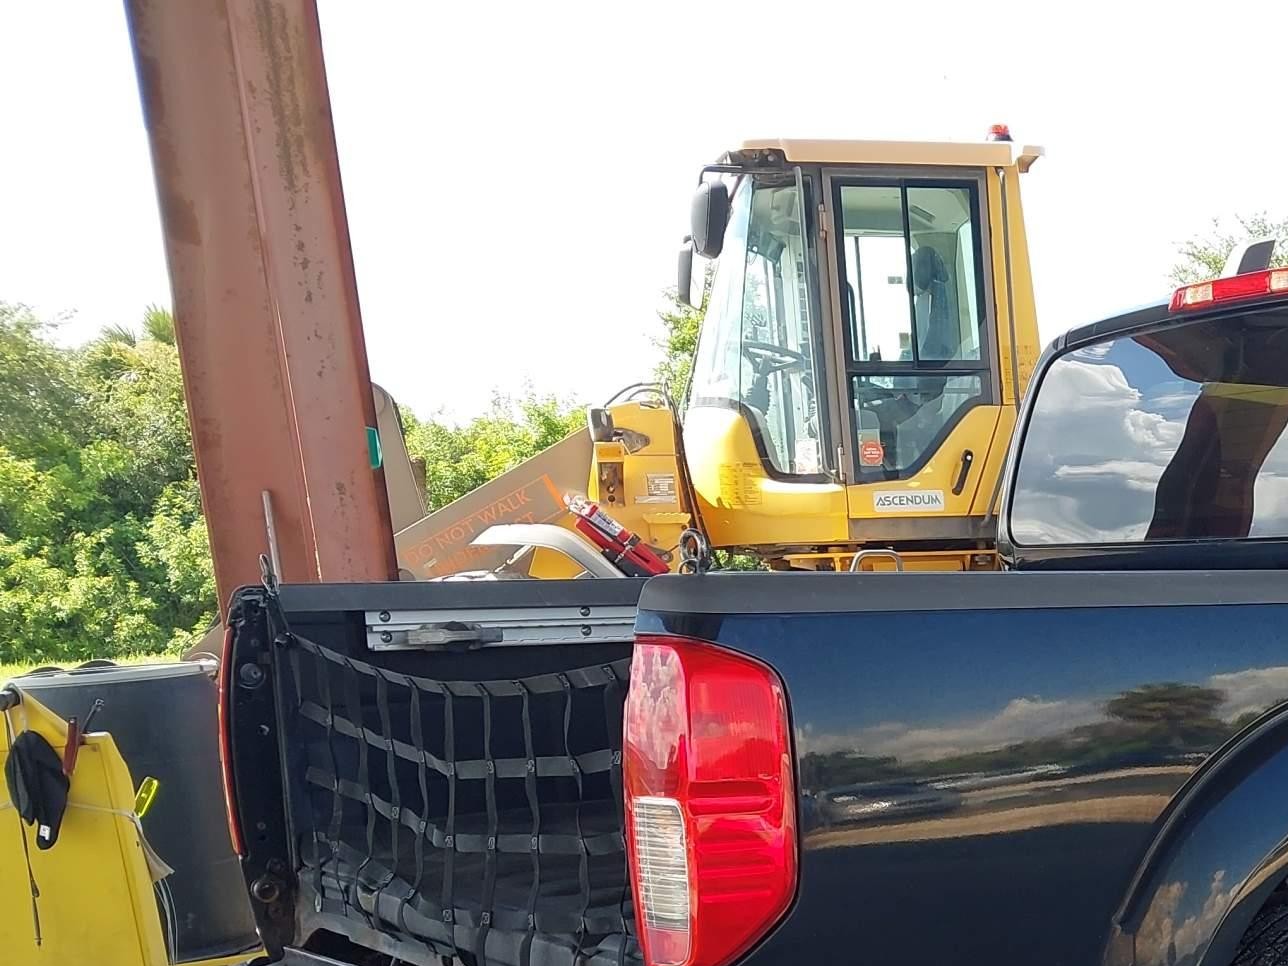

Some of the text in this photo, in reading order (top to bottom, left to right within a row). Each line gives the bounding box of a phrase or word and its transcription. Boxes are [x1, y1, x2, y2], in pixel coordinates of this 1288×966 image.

[876, 494, 941, 507] ASCENDUM
[405, 490, 530, 564] DO NOT WALK
